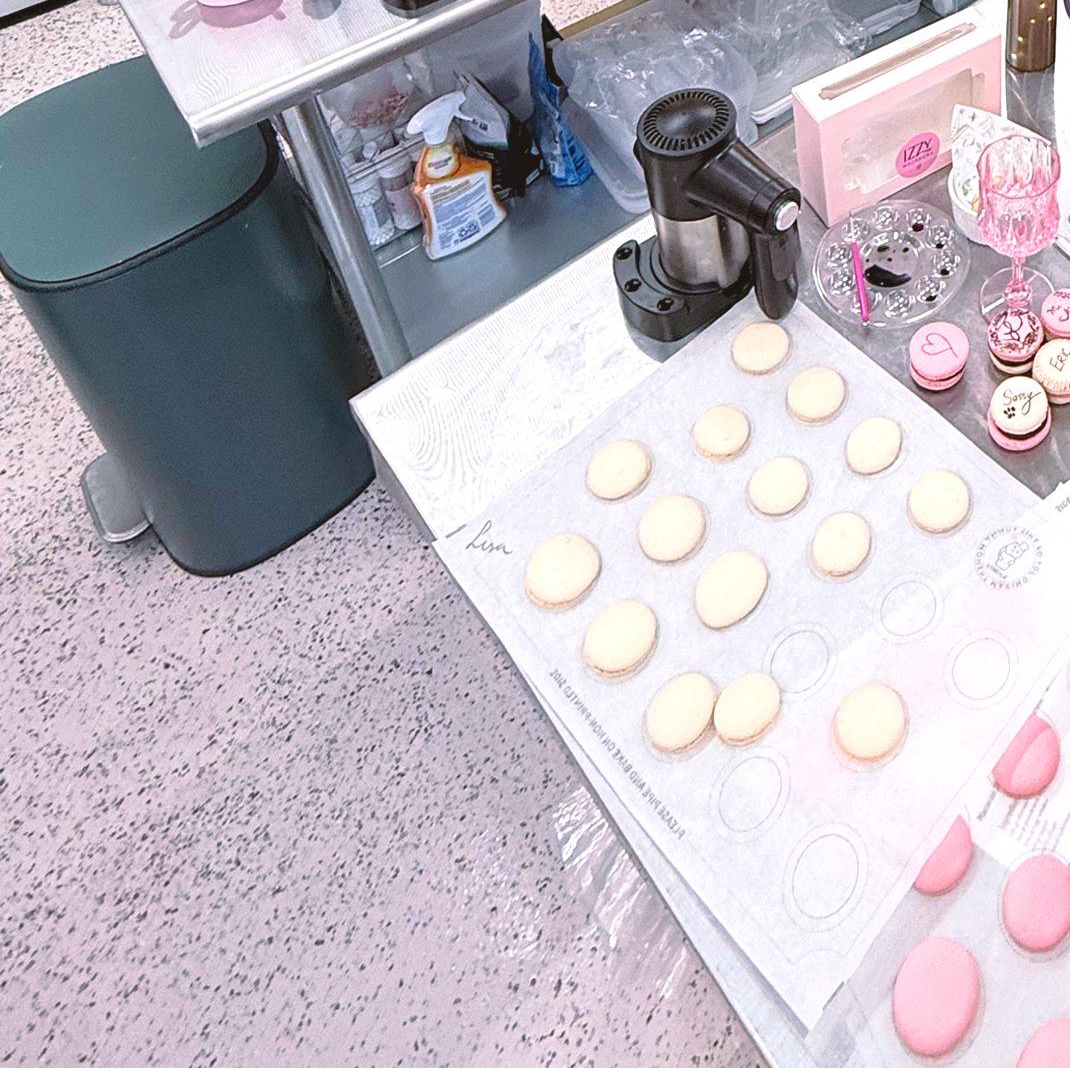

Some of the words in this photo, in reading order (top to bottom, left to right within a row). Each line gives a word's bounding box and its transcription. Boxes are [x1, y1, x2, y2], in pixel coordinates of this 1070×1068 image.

[903, 138, 932, 162] IZZY
[1050, 348, 1070, 372] ERIC
[1002, 389, 1042, 415] Sassy
[465, 520, 513, 555] Lisa
